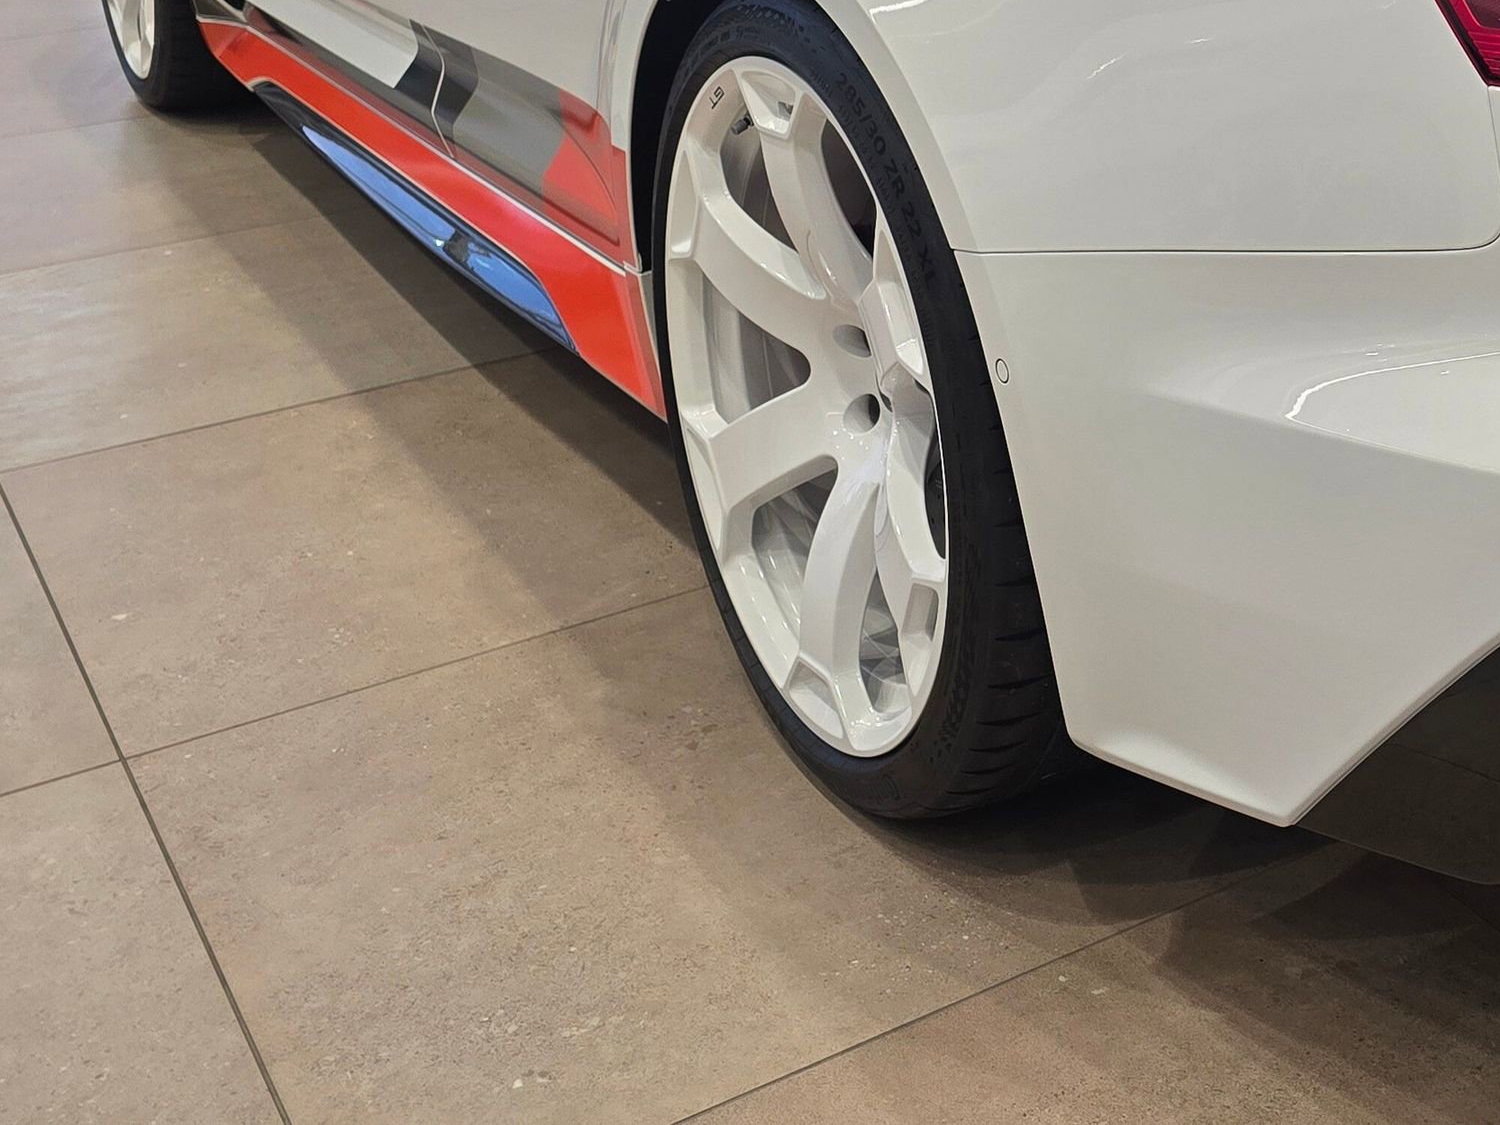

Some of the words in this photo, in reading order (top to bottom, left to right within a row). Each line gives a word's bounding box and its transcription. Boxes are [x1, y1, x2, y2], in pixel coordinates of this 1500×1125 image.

[834, 72, 887, 157] 285/30
[883, 158, 906, 199] ZR
[901, 201, 923, 238] 22
